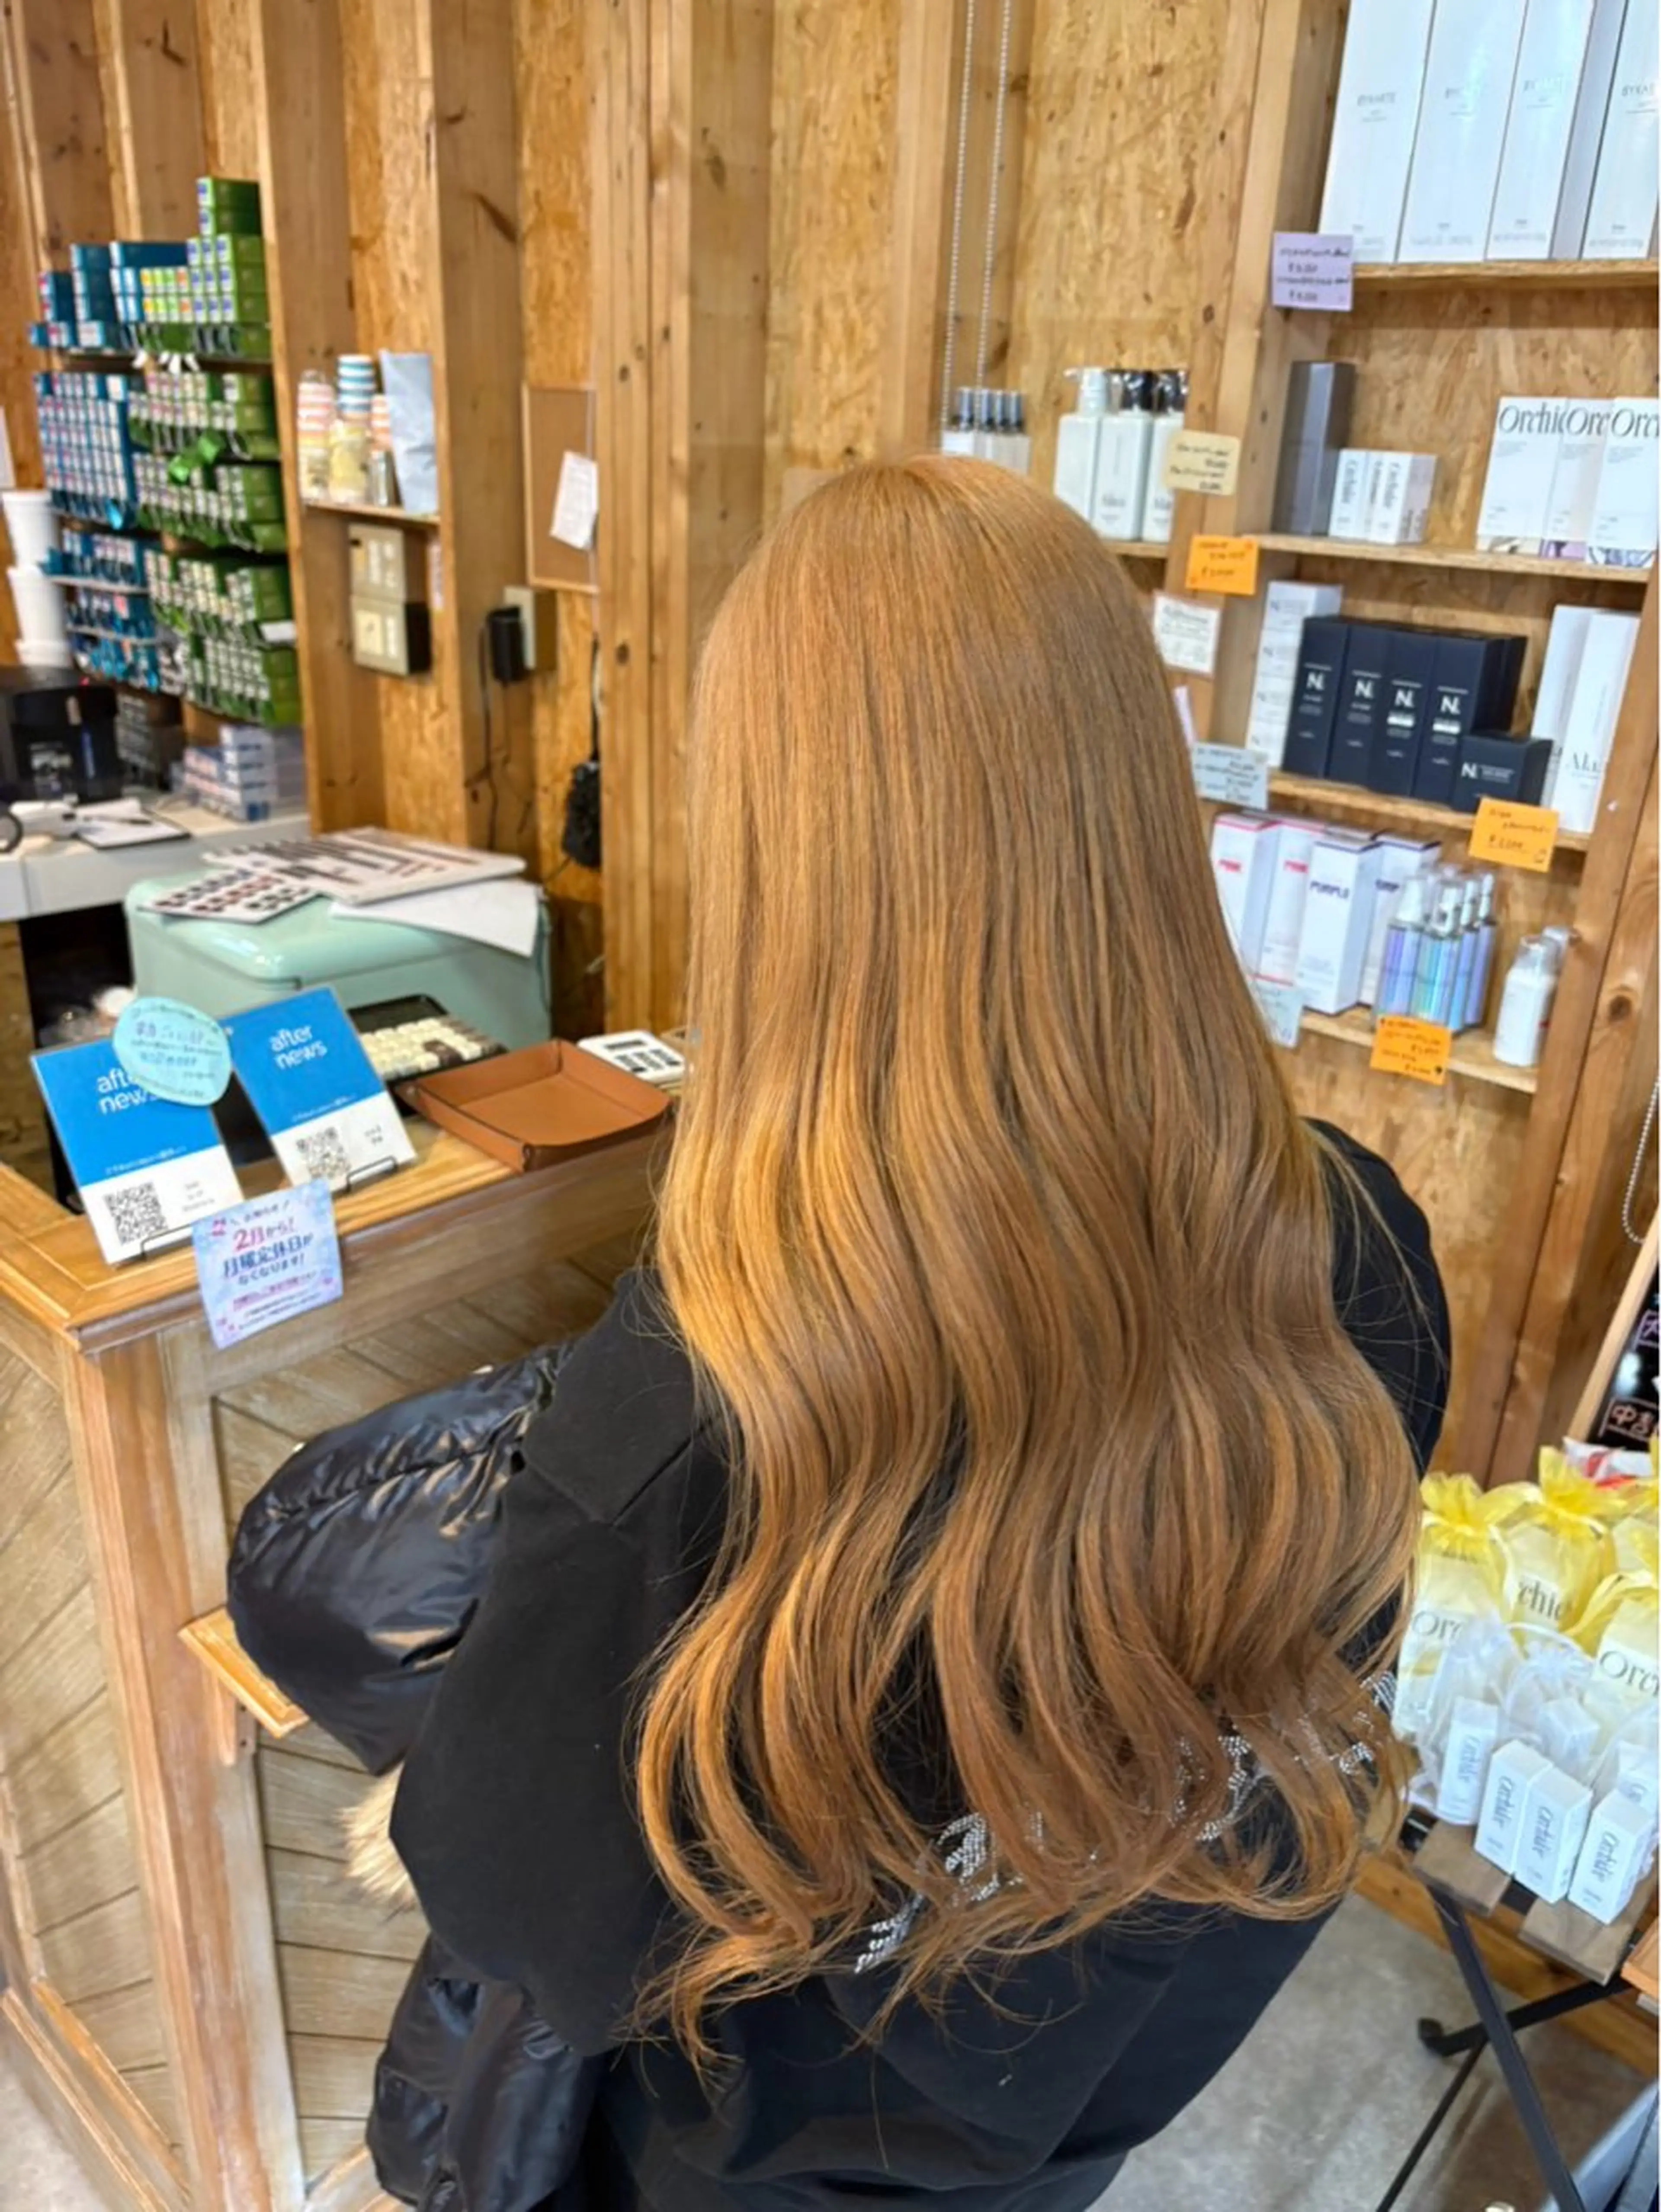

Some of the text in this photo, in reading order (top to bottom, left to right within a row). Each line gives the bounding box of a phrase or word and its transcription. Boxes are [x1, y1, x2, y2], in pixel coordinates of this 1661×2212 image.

[269, 1025, 312, 1052] after
[274, 1040, 328, 1070] news
[96, 1067, 138, 1093] aft
